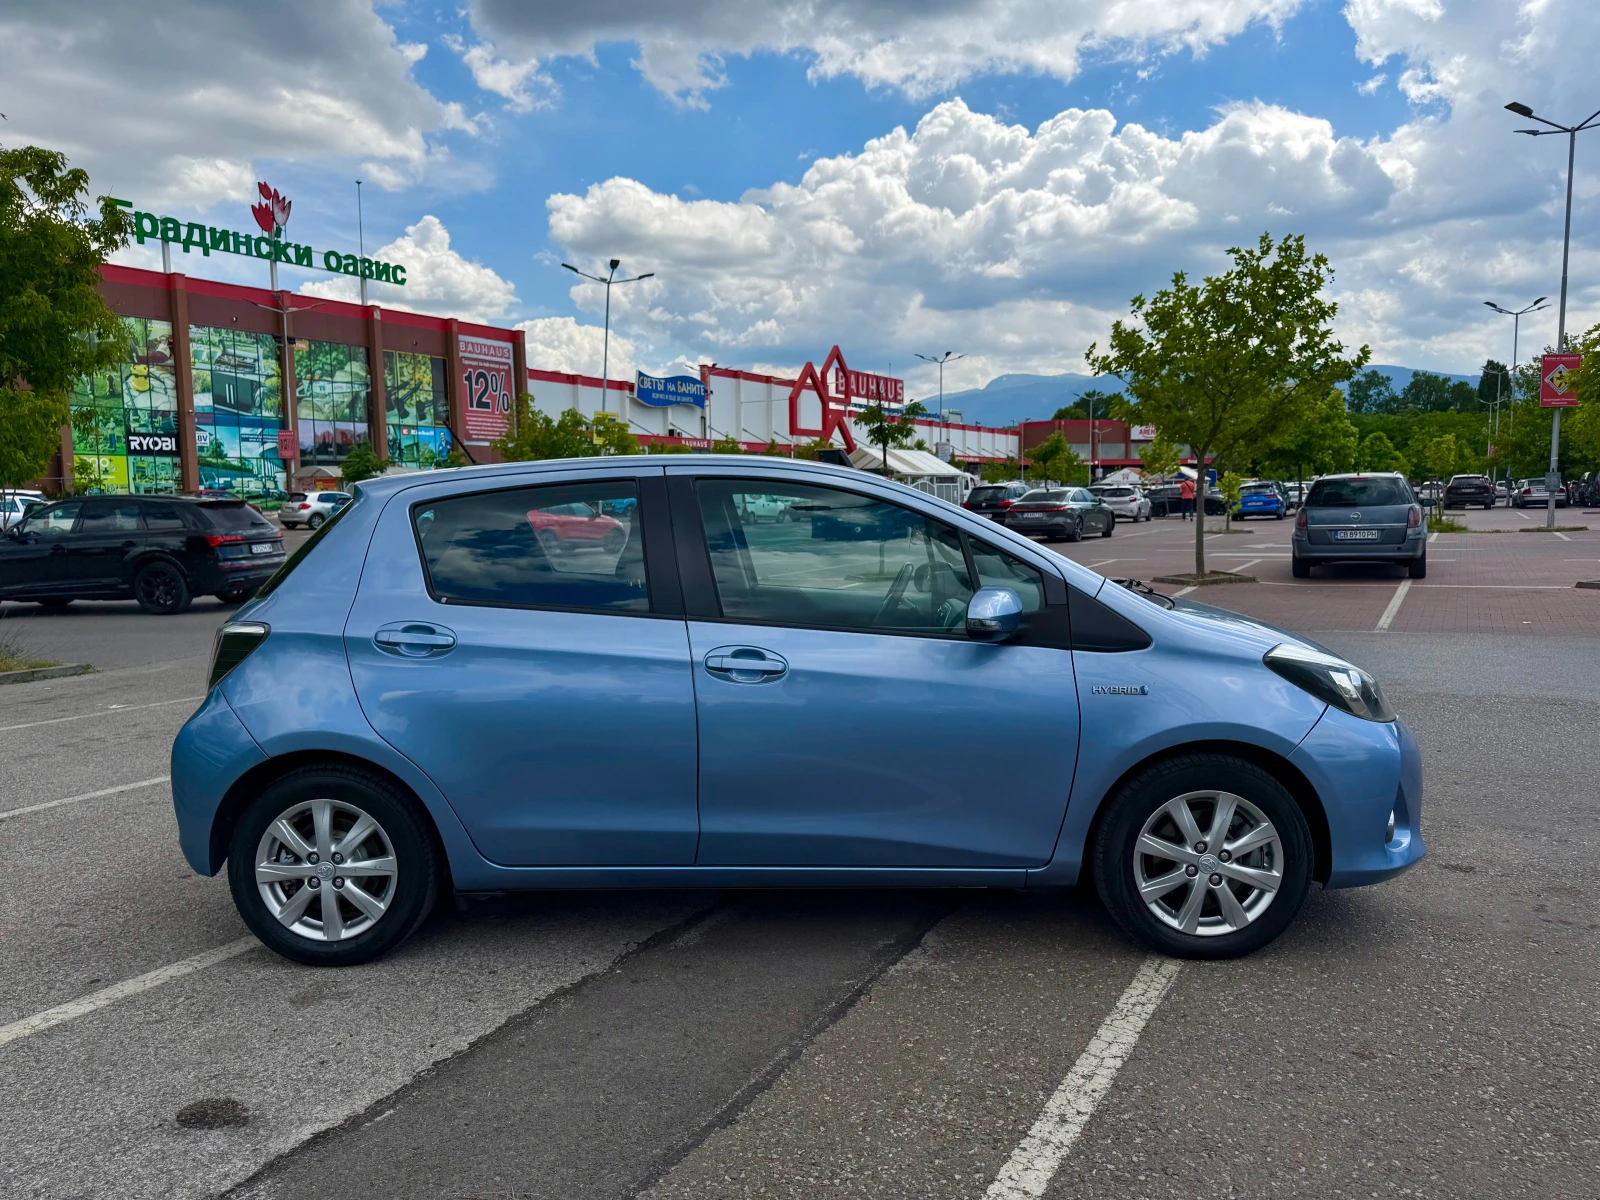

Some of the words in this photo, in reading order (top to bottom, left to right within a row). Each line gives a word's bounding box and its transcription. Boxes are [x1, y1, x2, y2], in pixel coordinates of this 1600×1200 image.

[323, 250, 407, 286] оазис
[460, 341, 510, 358] BAUHAUS
[463, 368, 511, 414] 12%
[639, 376, 665, 391] СВЕТЪТ
[677, 381, 705, 396] БАНИТЕ
[838, 370, 904, 401] BAUHAUS
[129, 435, 176, 451] RYOBI
[681, 440, 708, 448] BAUHAUS
[1092, 685, 1140, 695] HYBRID
